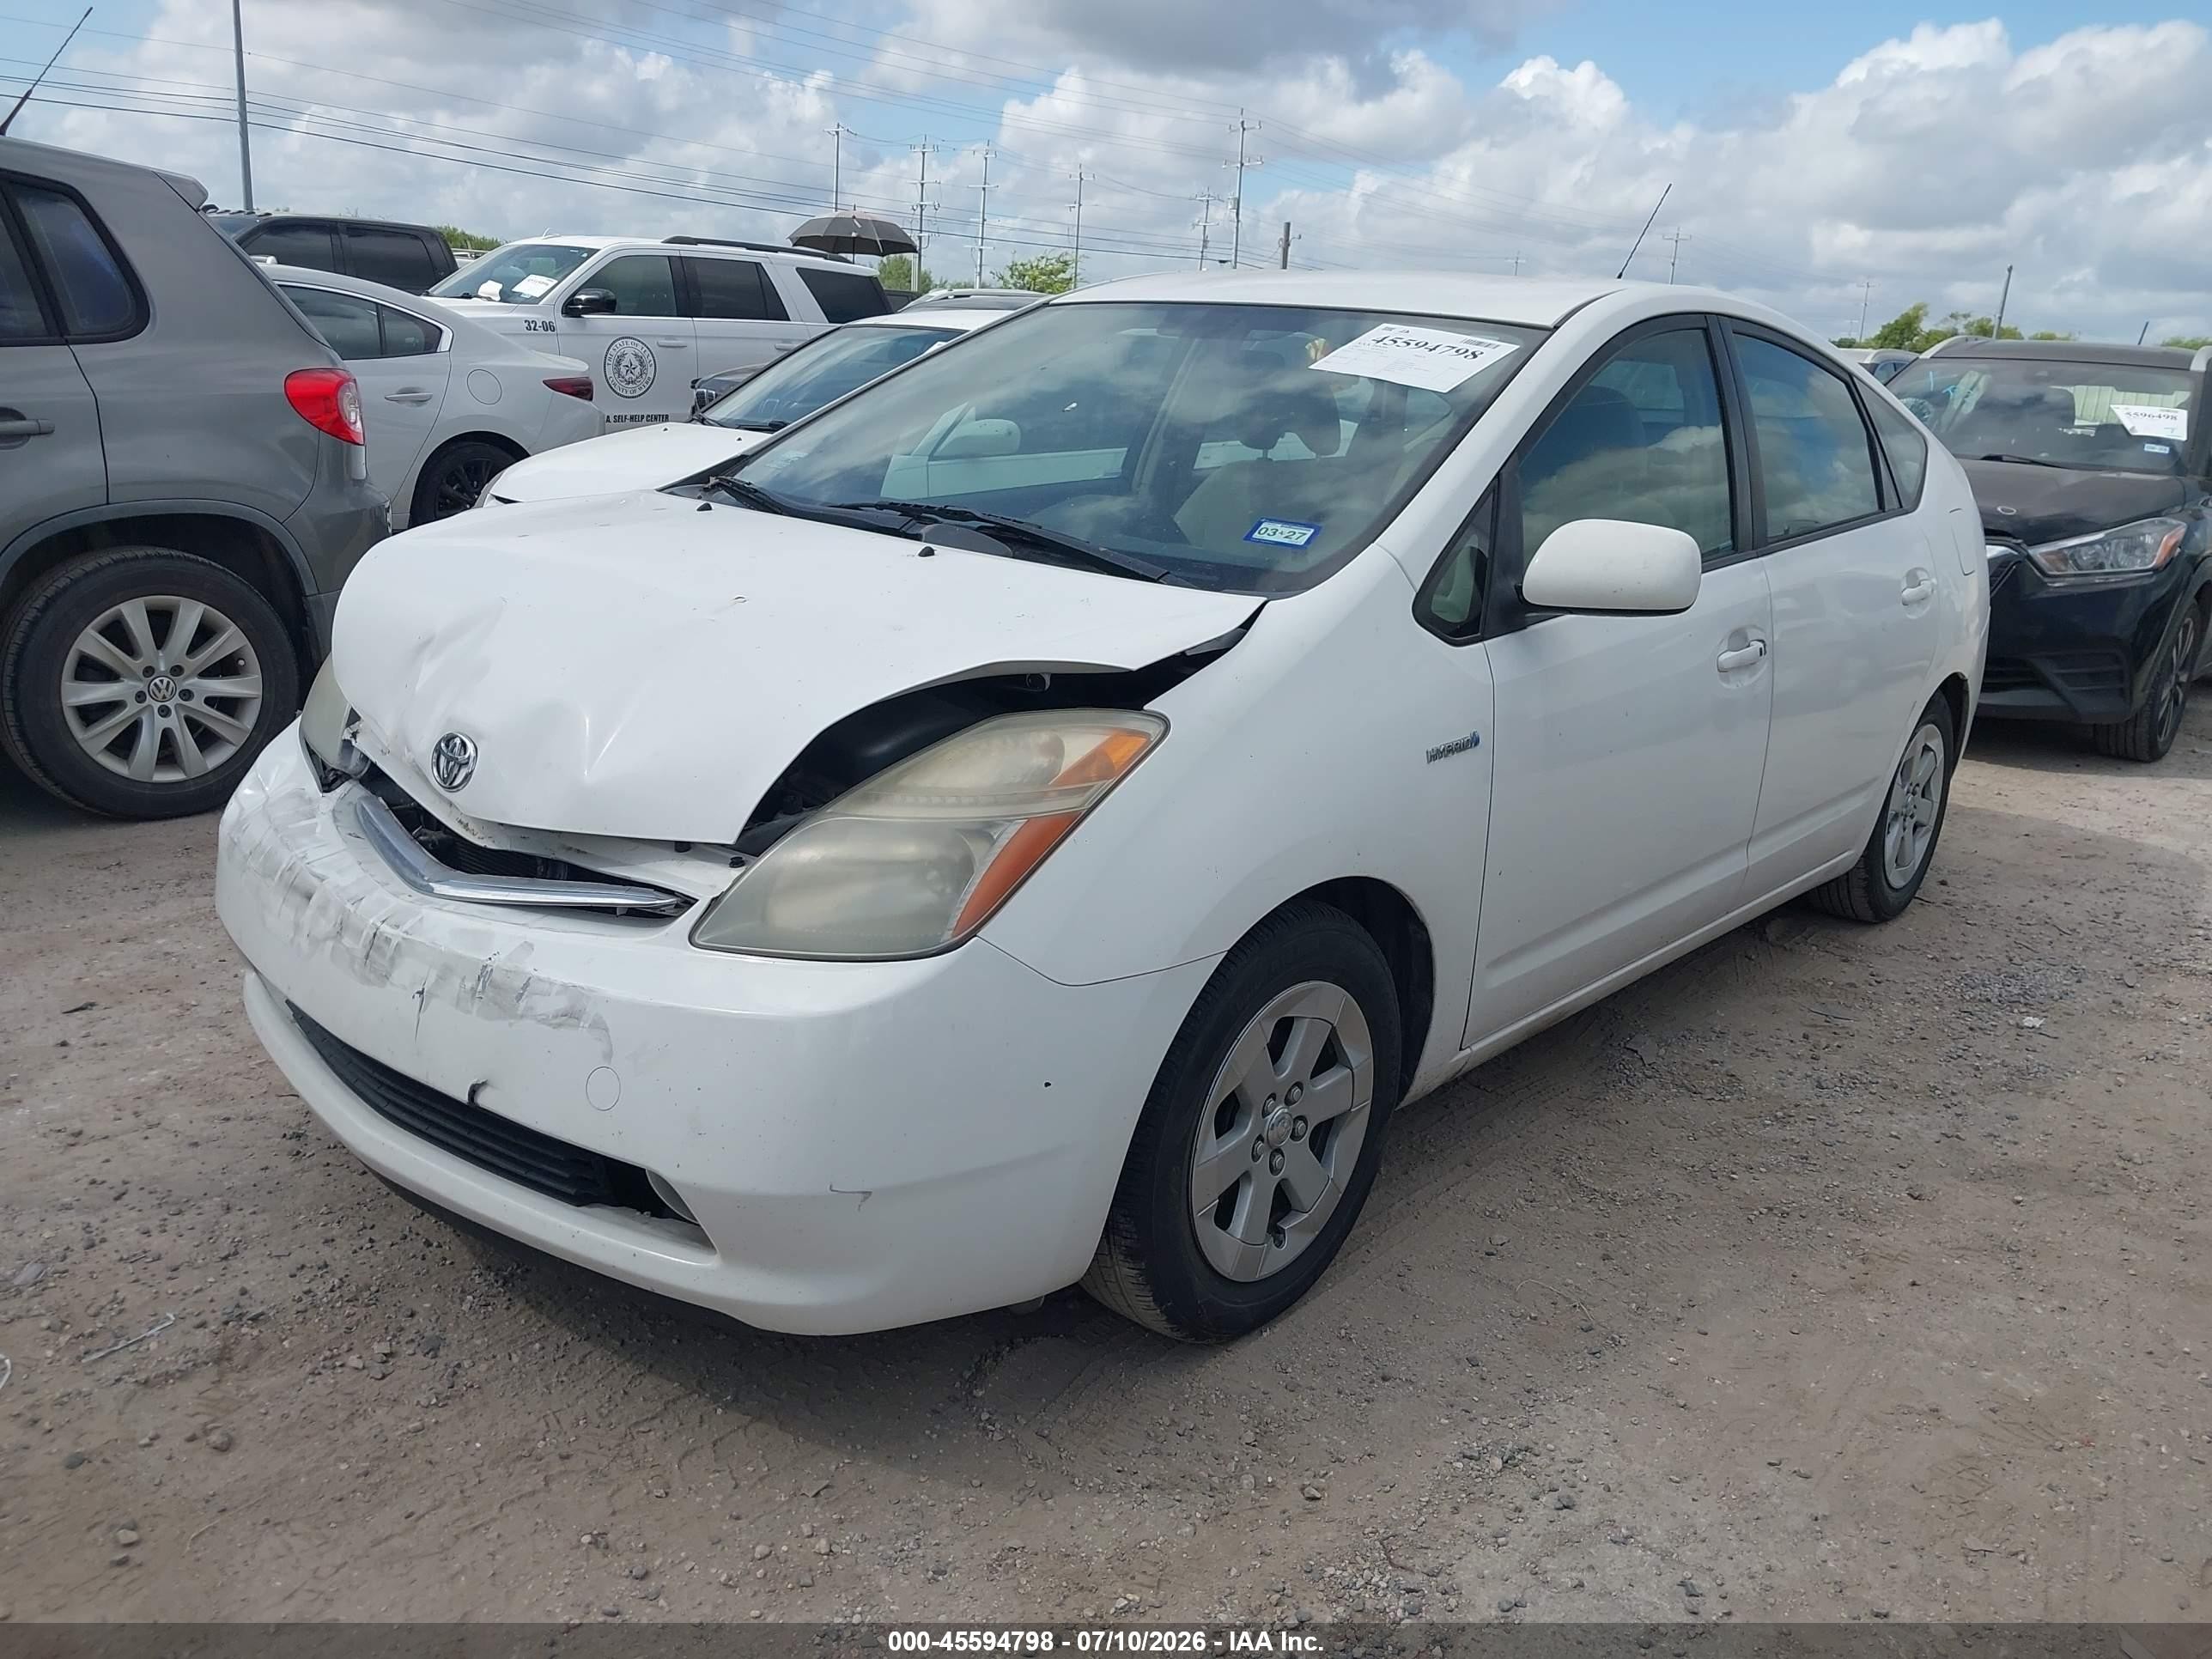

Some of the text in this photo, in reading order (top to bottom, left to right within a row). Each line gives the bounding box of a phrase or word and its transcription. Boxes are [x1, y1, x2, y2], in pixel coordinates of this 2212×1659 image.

[525, 319, 556, 332] 32-06
[612, 341, 629, 351] STATE
[641, 345, 653, 368] TEXAS
[1371, 335, 1485, 361] 45594798
[610, 376, 628, 394] COUNTY
[613, 414, 645, 423] SELF-HELP
[646, 414, 669, 422] CENTER
